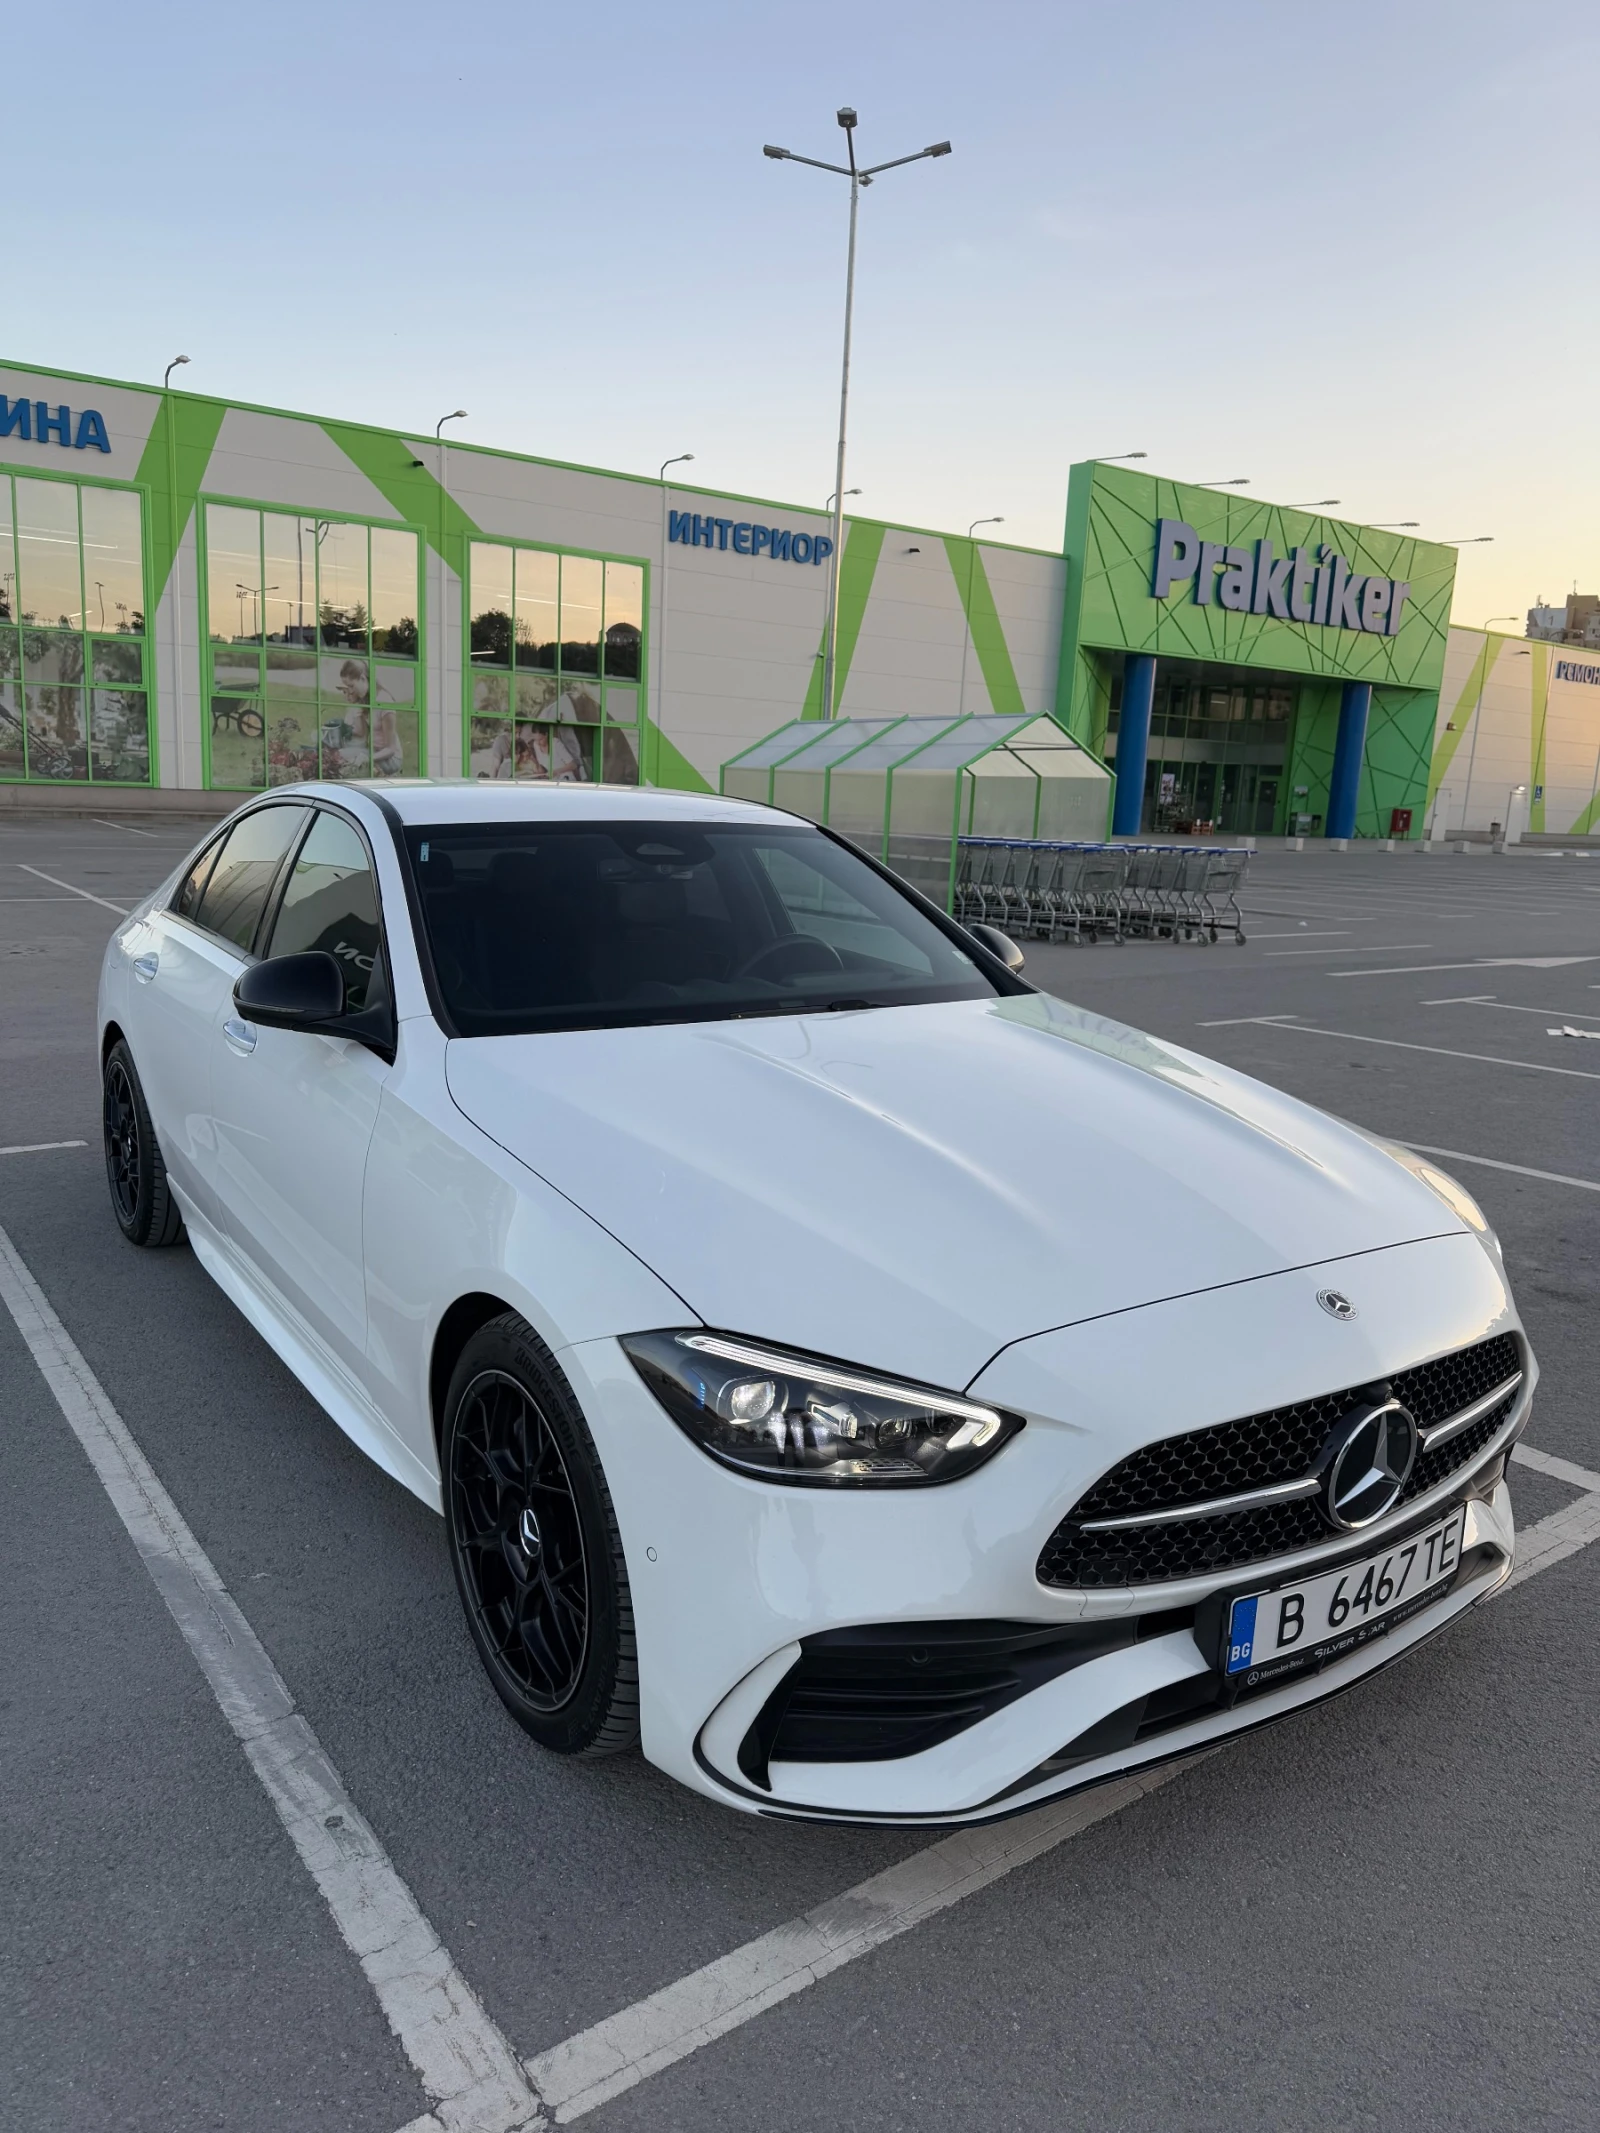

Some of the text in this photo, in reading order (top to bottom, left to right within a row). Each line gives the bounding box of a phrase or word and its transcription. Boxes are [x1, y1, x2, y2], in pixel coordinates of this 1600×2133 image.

[0, 394, 112, 453] ИНА
[669, 509, 833, 566] ИНТЕРИОР
[1151, 517, 1410, 636] Praktiker
[1276, 1516, 1459, 1648] B 6467 TE
[1231, 1642, 1251, 1662] BG
[1259, 1657, 1305, 1680] Mercedes-Benz
[1314, 1636, 1355, 1658] SILVER
